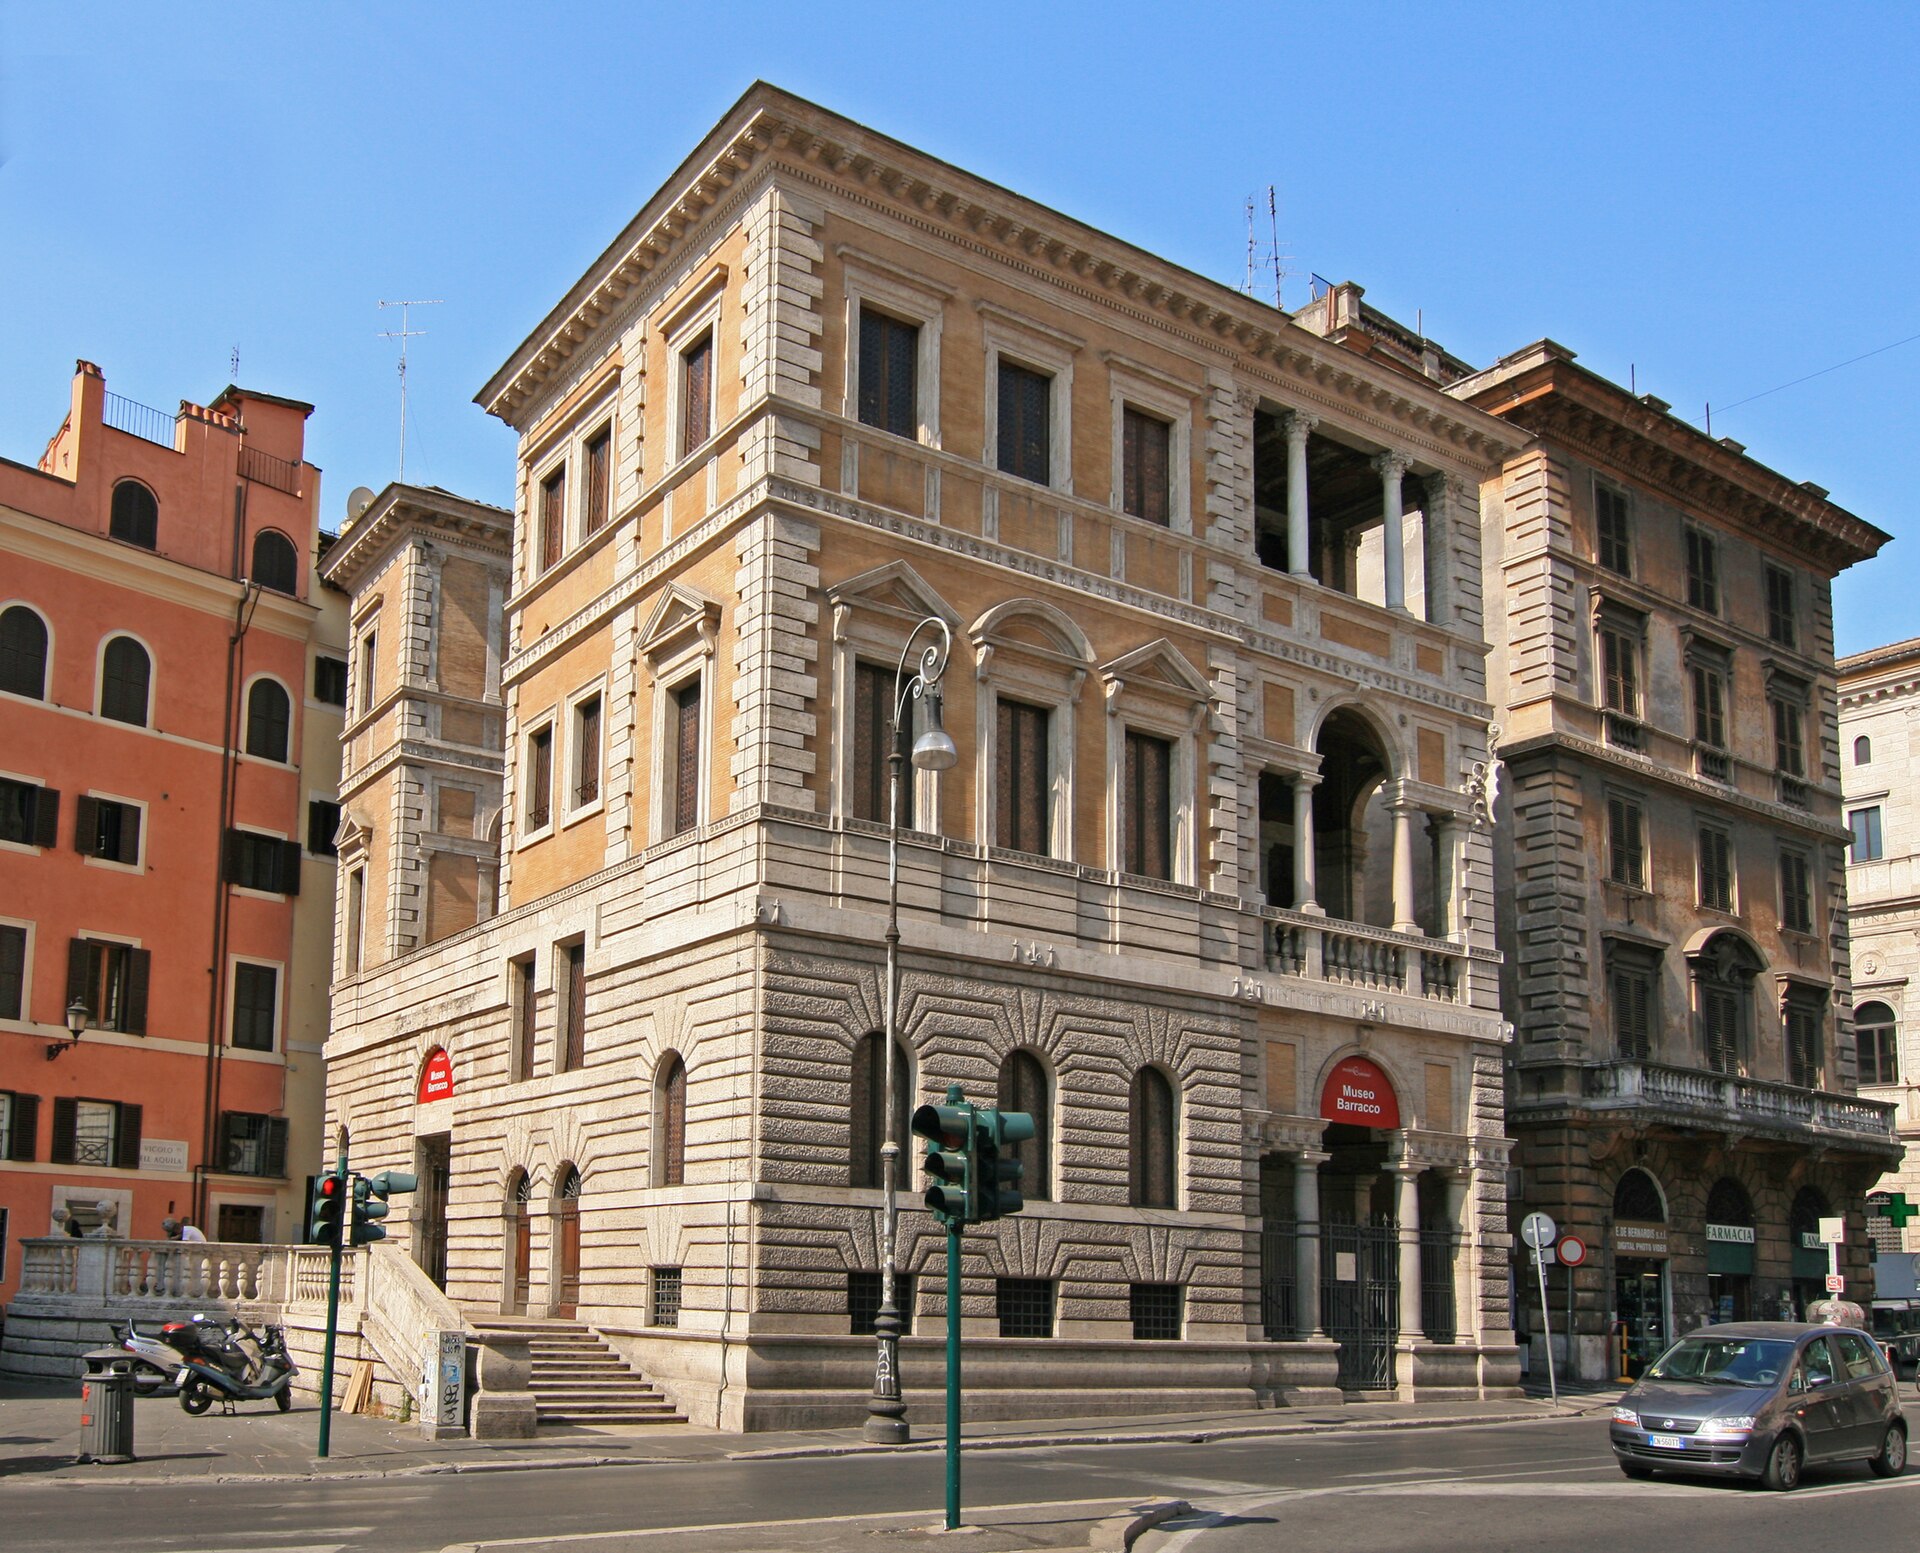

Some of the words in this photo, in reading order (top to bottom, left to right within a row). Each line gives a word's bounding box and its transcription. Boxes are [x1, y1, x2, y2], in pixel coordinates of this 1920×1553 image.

[430, 1070, 446, 1080] Museo
[1342, 1084, 1375, 1100] Museo
[1336, 1097, 1380, 1114] Barracco
[144, 1145, 174, 1154] VICOLO
[1706, 1226, 1753, 1242] FARMACIA
